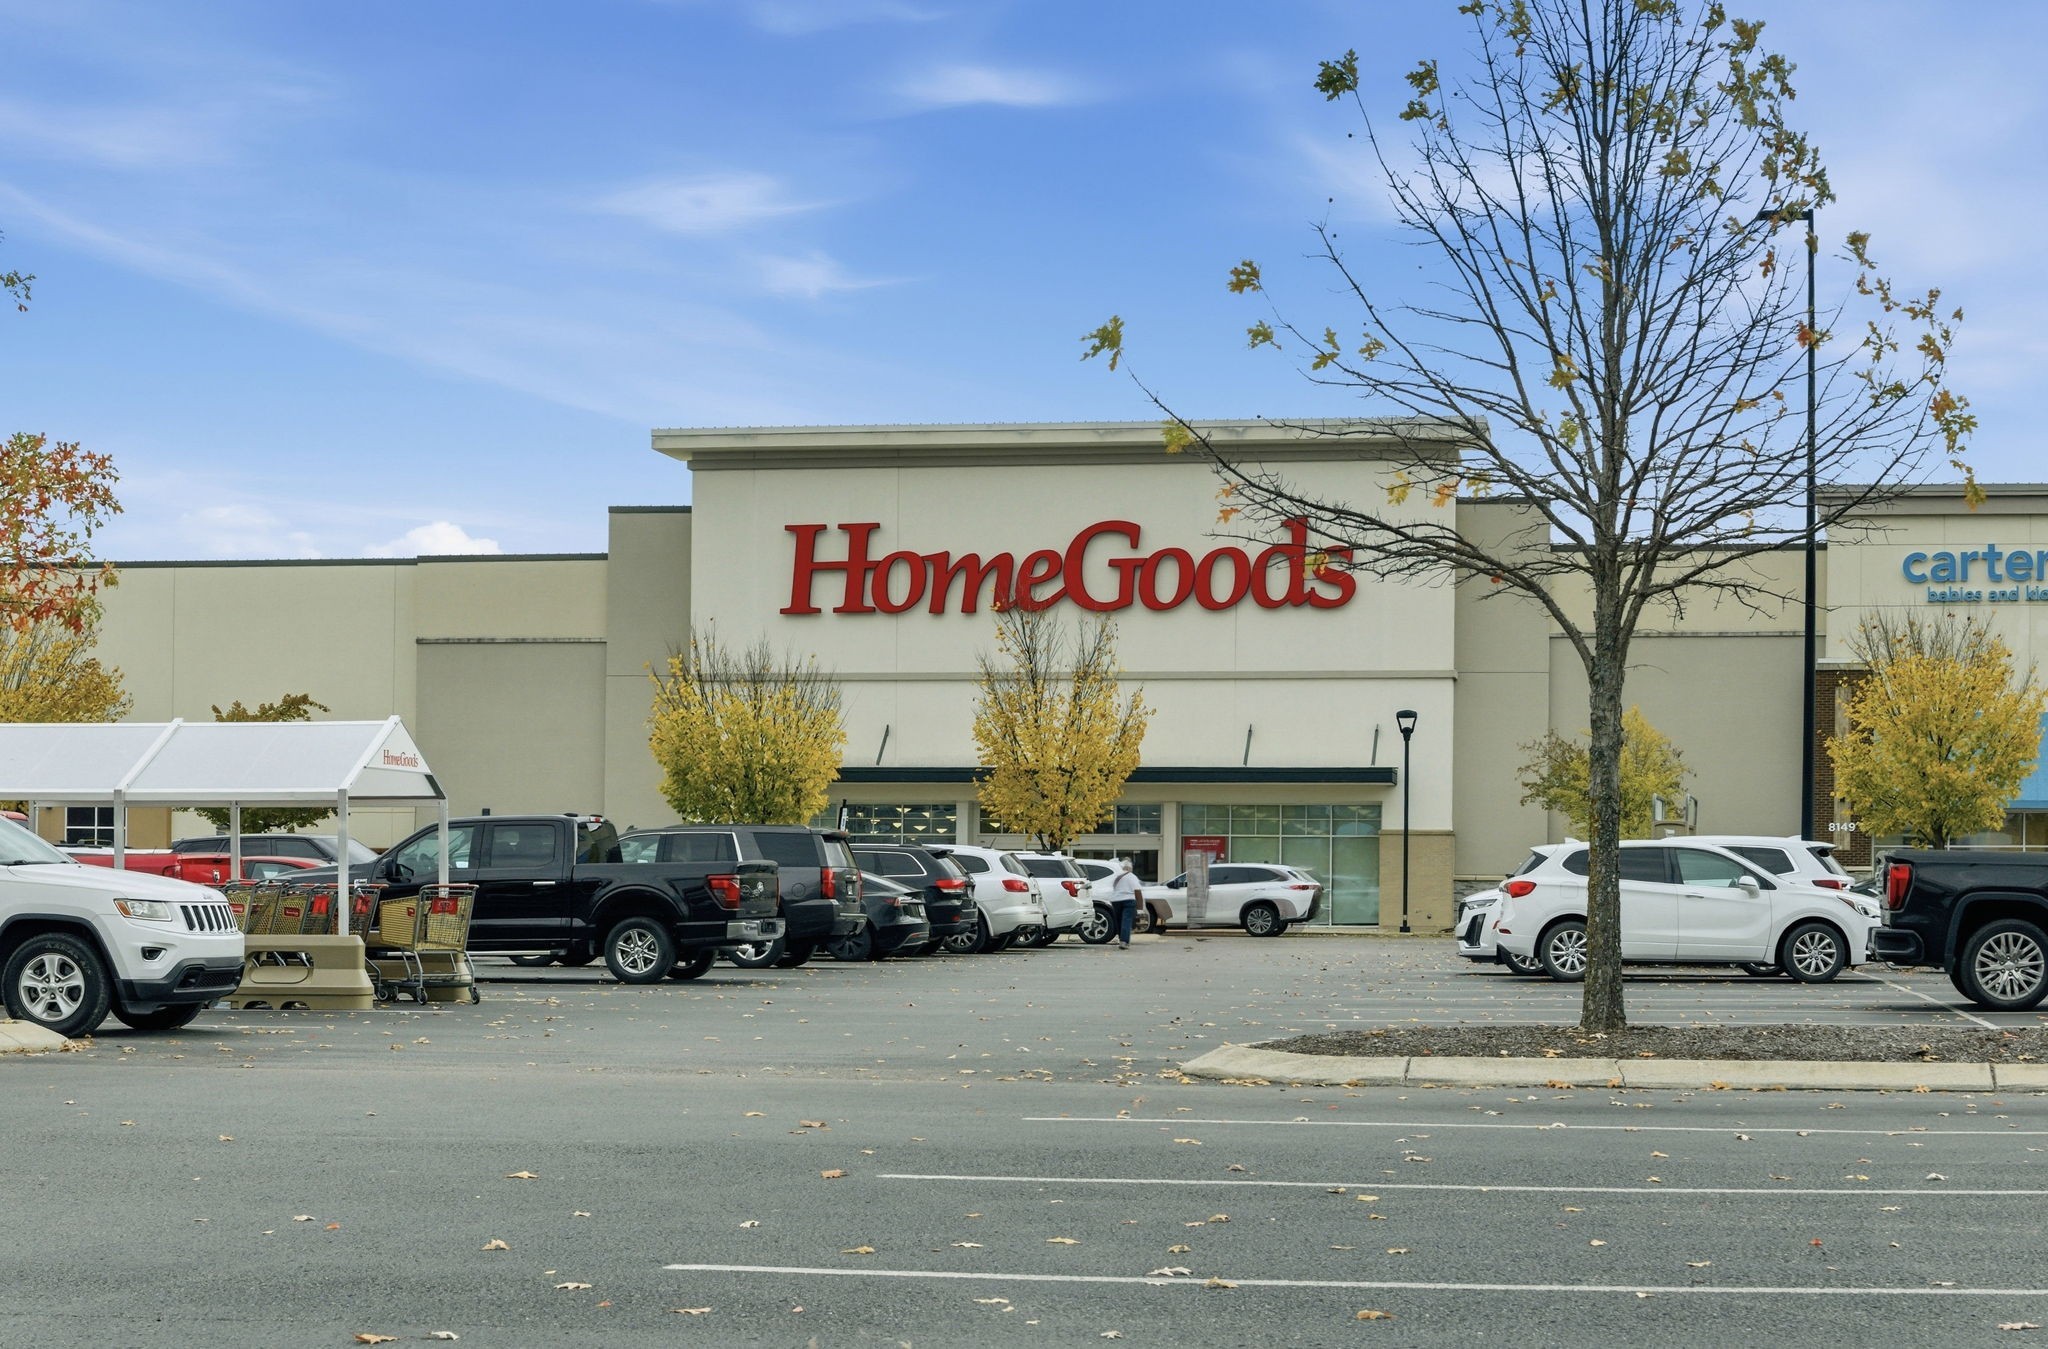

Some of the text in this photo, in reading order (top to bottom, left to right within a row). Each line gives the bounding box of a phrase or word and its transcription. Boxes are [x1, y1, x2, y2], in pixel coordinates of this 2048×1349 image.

[780, 515, 1357, 614] HomeGoods
[1928, 586, 1982, 602] babies
[1989, 586, 2019, 602] and
[1828, 822, 1856, 832] 8149
